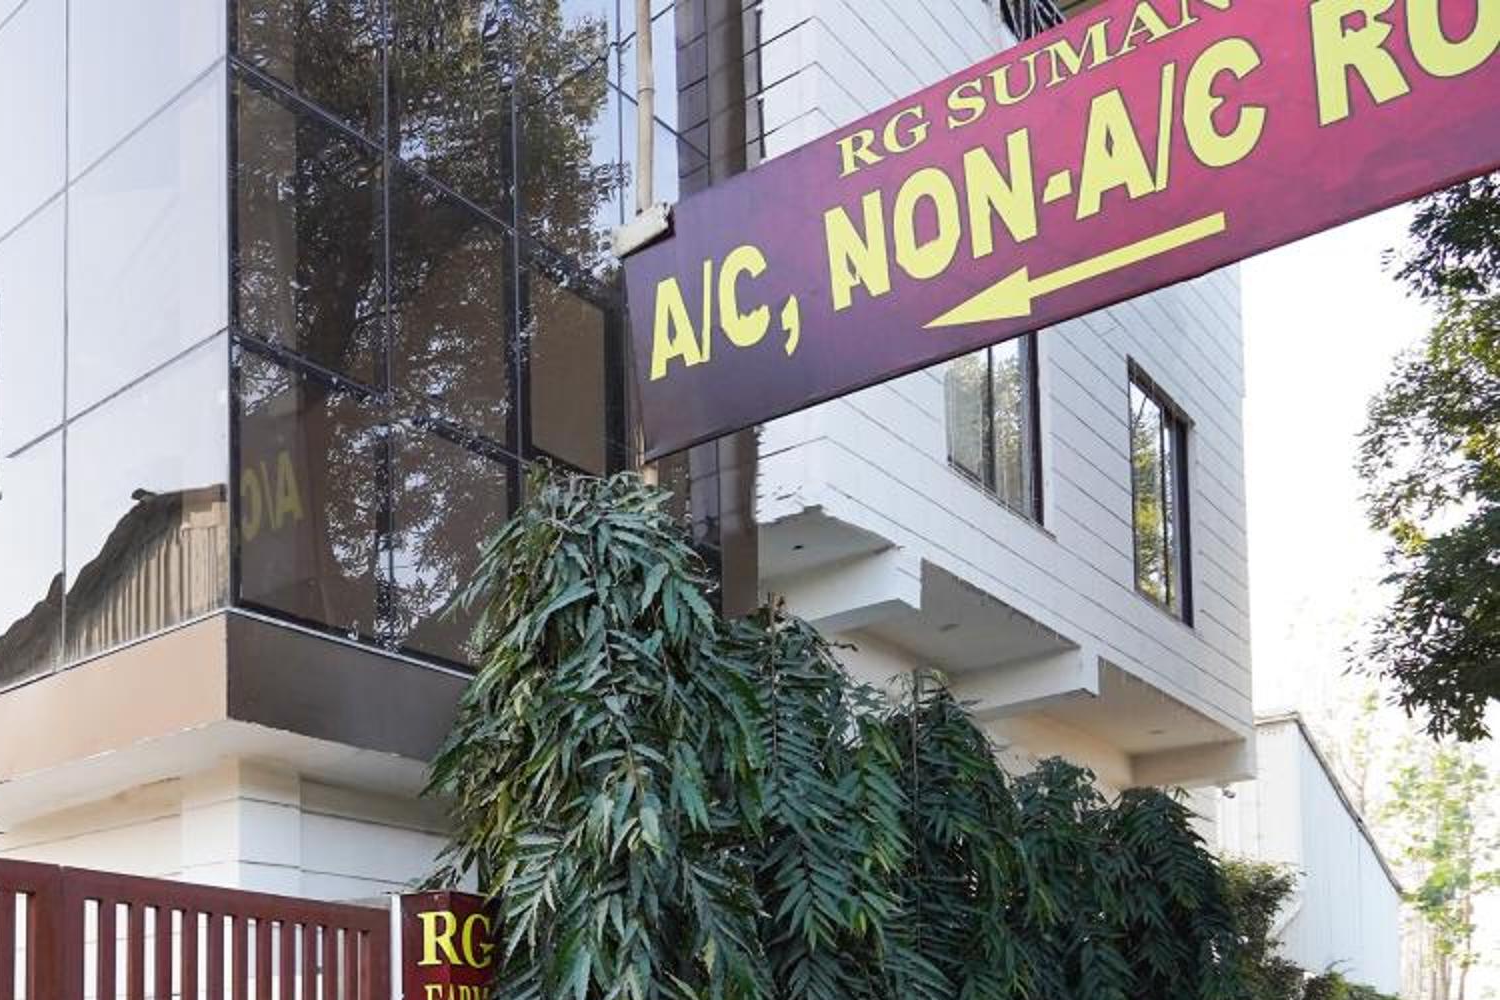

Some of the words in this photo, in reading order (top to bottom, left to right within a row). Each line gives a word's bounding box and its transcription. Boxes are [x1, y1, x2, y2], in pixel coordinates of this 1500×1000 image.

[836, 104, 931, 177] RG
[649, 244, 802, 382] A/C,
[822, 37, 1266, 311] NON-A/C
[416, 909, 495, 969] RG
